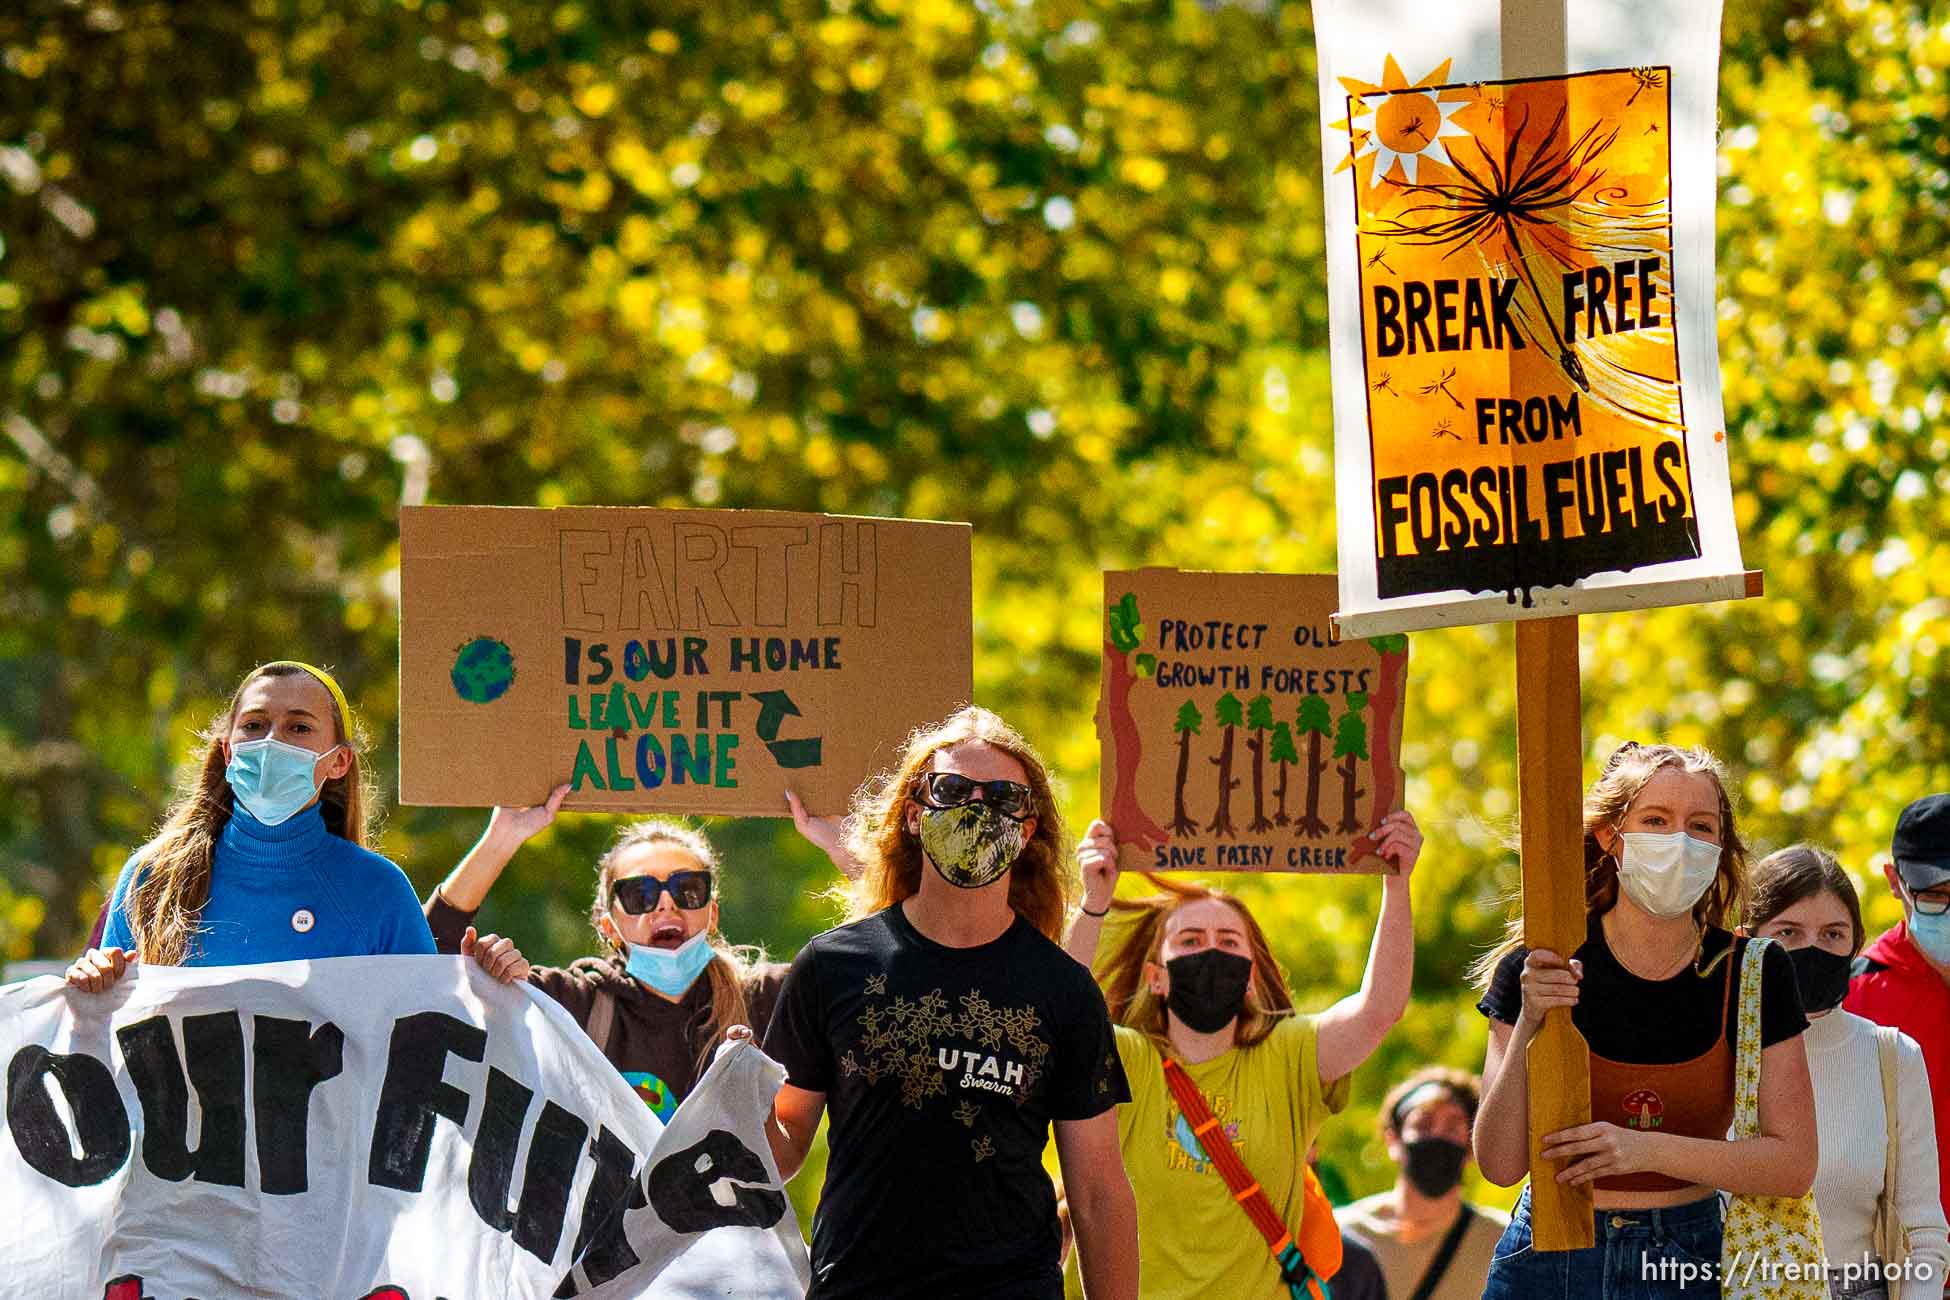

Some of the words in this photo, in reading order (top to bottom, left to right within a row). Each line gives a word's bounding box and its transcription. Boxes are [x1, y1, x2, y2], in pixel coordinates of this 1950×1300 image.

[1373, 277, 1525, 357] BREAK
[1562, 257, 1661, 343] FREE
[1476, 392, 1582, 445] FROM
[1378, 465, 1540, 556] FOSSIL
[1543, 440, 1689, 540] FUELS
[559, 521, 878, 631] EARTH
[1158, 618, 1268, 651] PROTECT
[564, 637, 613, 685] IS
[623, 637, 709, 682] OUR
[730, 637, 842, 673] HOME
[1156, 661, 1250, 690] GROWTH
[1261, 667, 1374, 695] FORESTS
[568, 683, 681, 731] LEAVE
[697, 690, 744, 729] IT
[571, 732, 739, 792] ALONE
[1154, 844, 1207, 868] SAVE
[1216, 844, 1274, 866] FAIRY
[1286, 845, 1348, 868] CREEK
[938, 1047, 1024, 1085] UTAH
[959, 1072, 1014, 1096] Swarm
[7, 1009, 344, 1195] our
